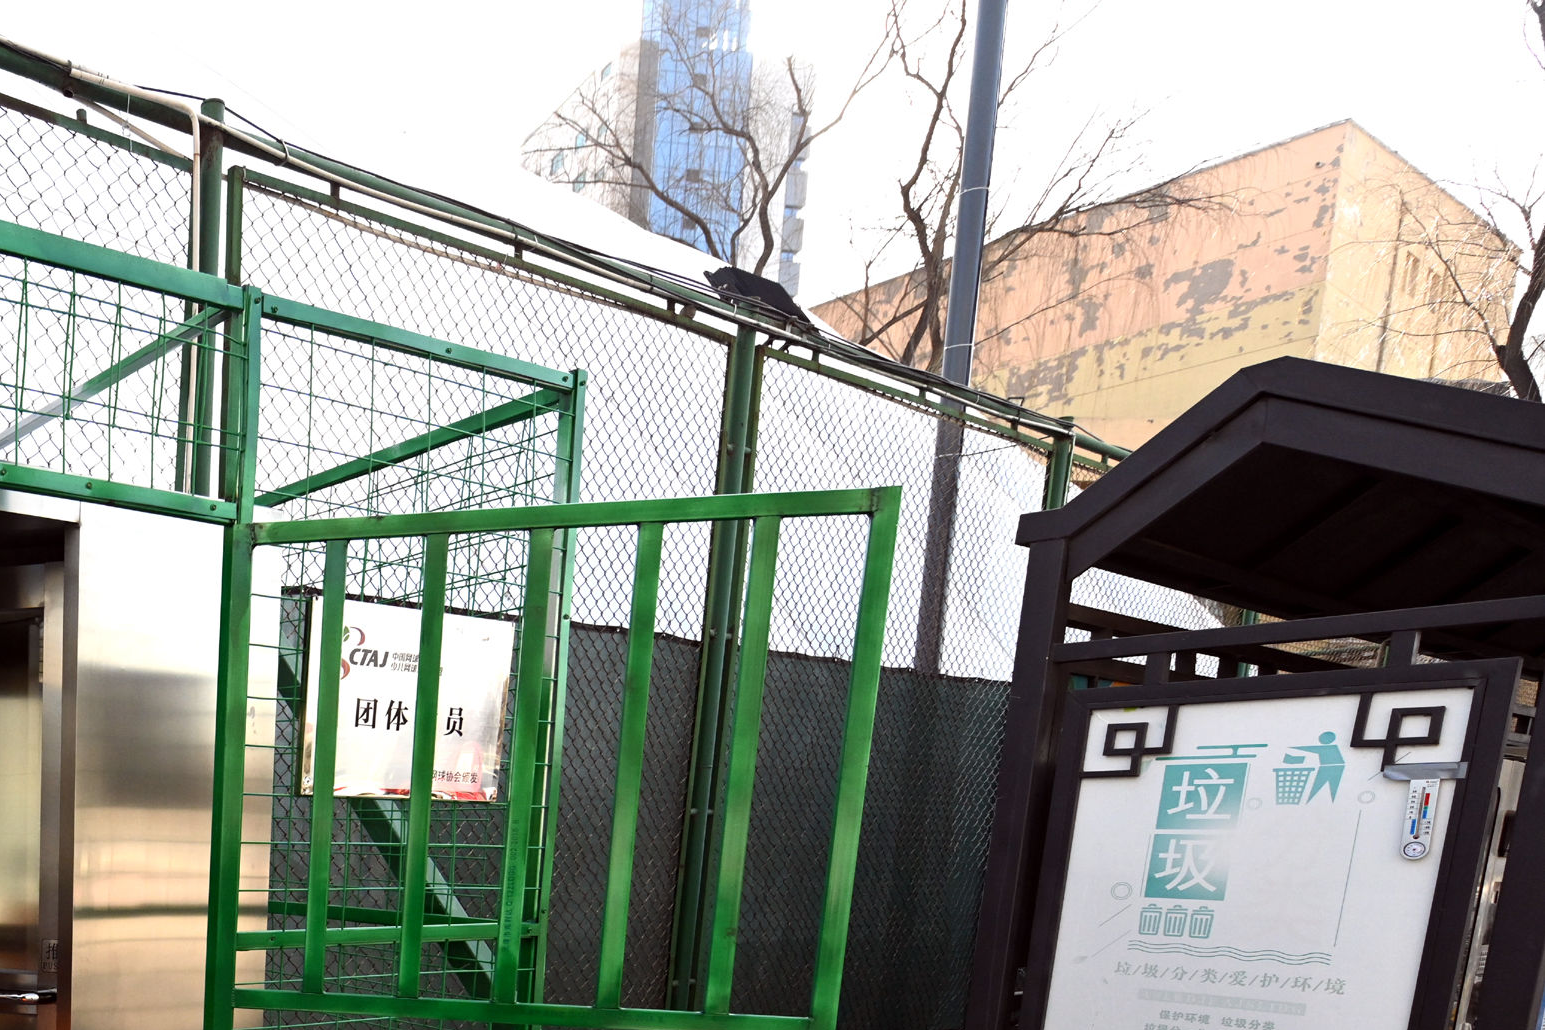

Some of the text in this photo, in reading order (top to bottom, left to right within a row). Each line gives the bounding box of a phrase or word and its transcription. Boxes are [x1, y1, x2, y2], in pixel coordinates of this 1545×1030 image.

[349, 648, 389, 668] CTAJ
[354, 697, 465, 737] 团体员
[1154, 767, 1235, 893] 垃圾
[1159, 1010, 1210, 1025] 保护环境
